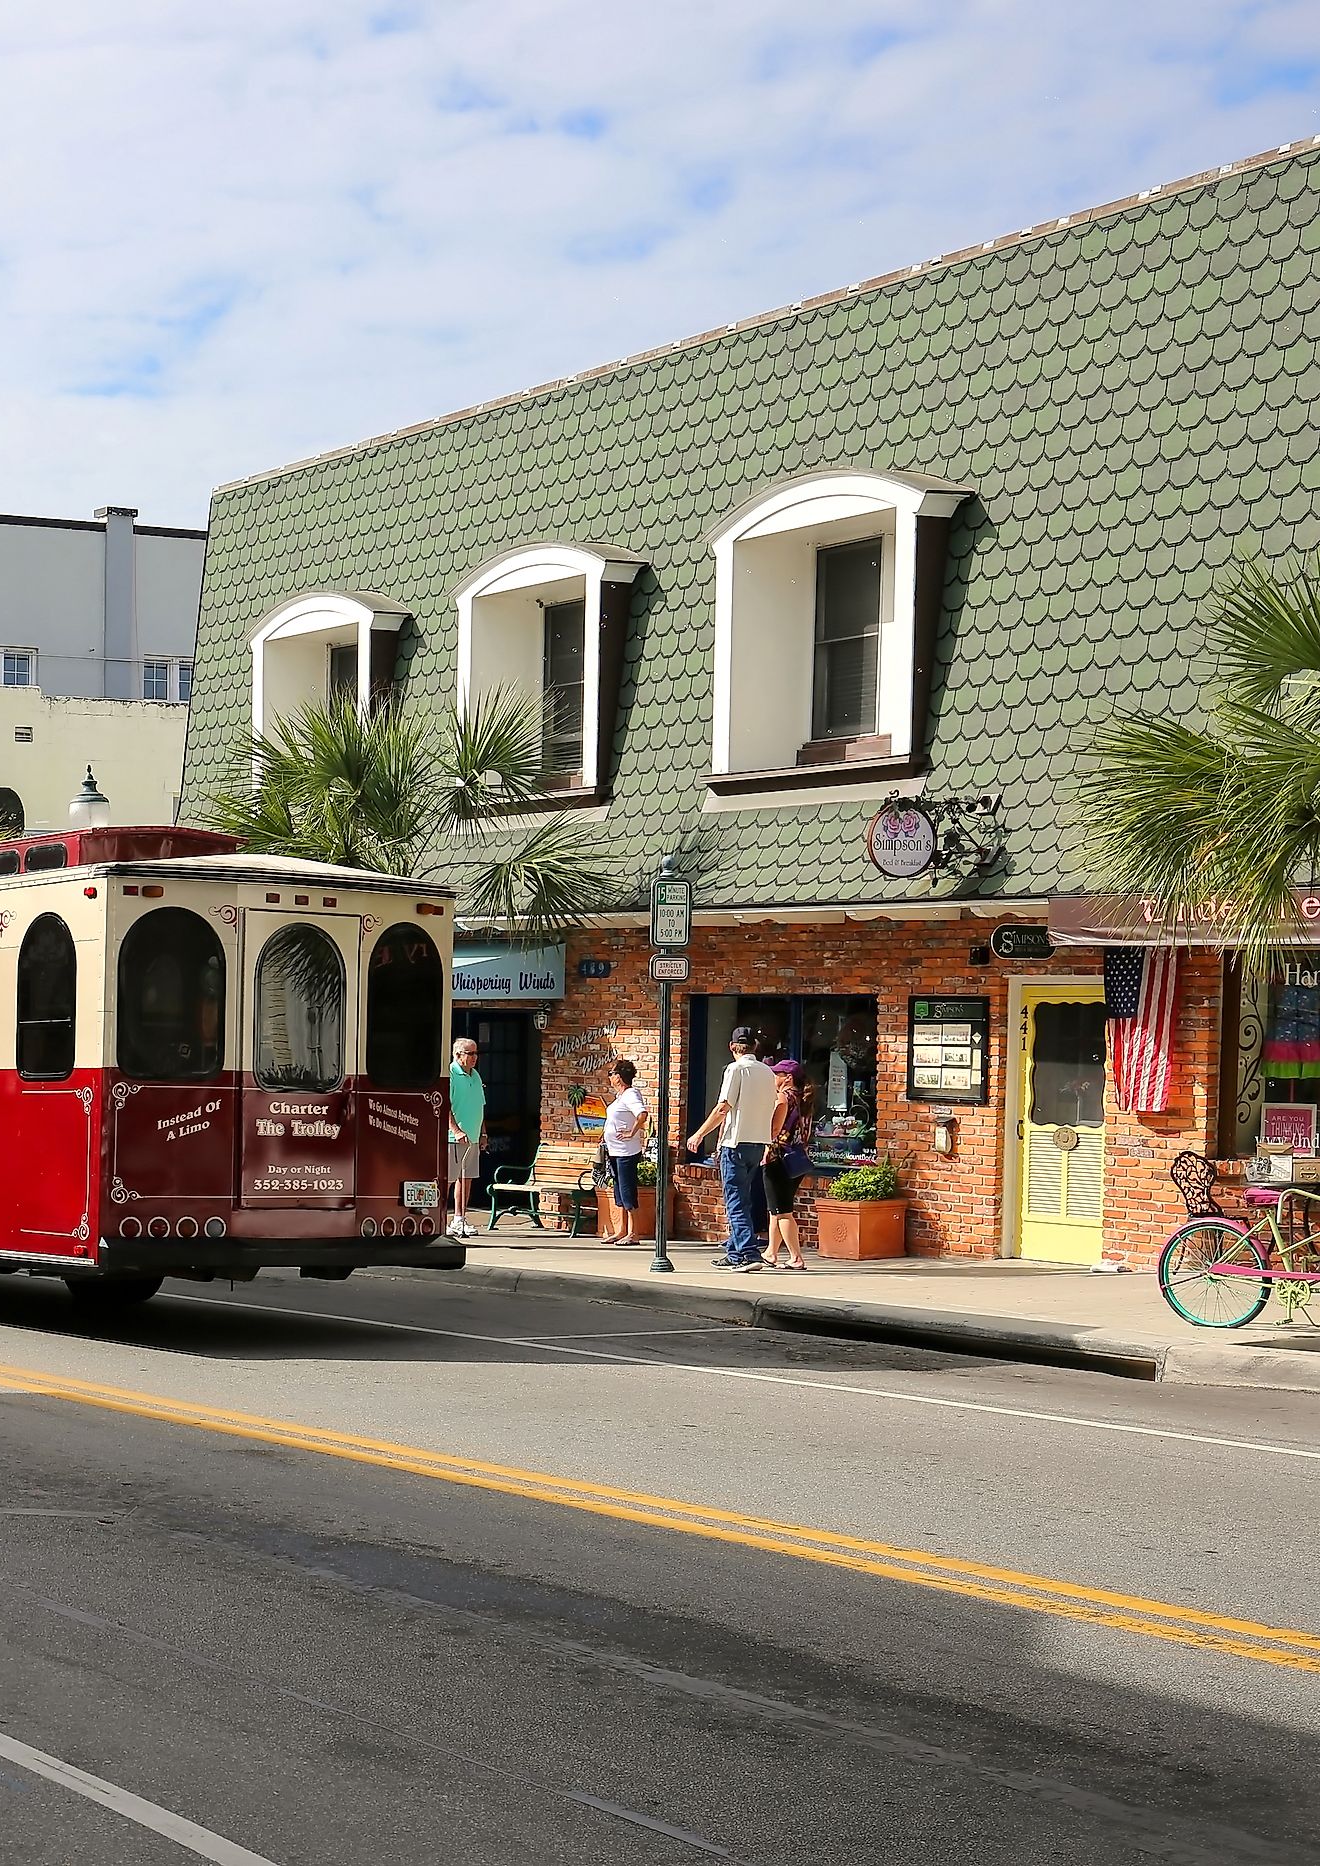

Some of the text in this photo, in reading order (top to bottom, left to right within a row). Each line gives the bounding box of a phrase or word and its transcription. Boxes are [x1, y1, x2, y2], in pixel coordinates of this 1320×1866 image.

[873, 833, 932, 857] Simpson's
[658, 886, 666, 902] 15
[676, 909, 684, 918] AM
[668, 919, 676, 928] TO
[660, 929, 683, 938] 5:00 PM
[658, 968, 684, 976] ENFORCED
[519, 972, 555, 992] Winds
[551, 1020, 618, 1059] Whispering
[579, 1047, 619, 1074] Winds
[269, 1101, 330, 1115] Charter
[368, 1098, 376, 1111] We
[375, 1101, 383, 1114] Go
[157, 1099, 222, 1131] Instead Of
[368, 1114, 376, 1127] We
[166, 1120, 211, 1141] A Limo
[255, 1119, 342, 1140] The Trolley
[1271, 1122, 1305, 1137] THINKING
[267, 1165, 332, 1176] Day or Night
[253, 1179, 345, 1191] 352-385-1023
